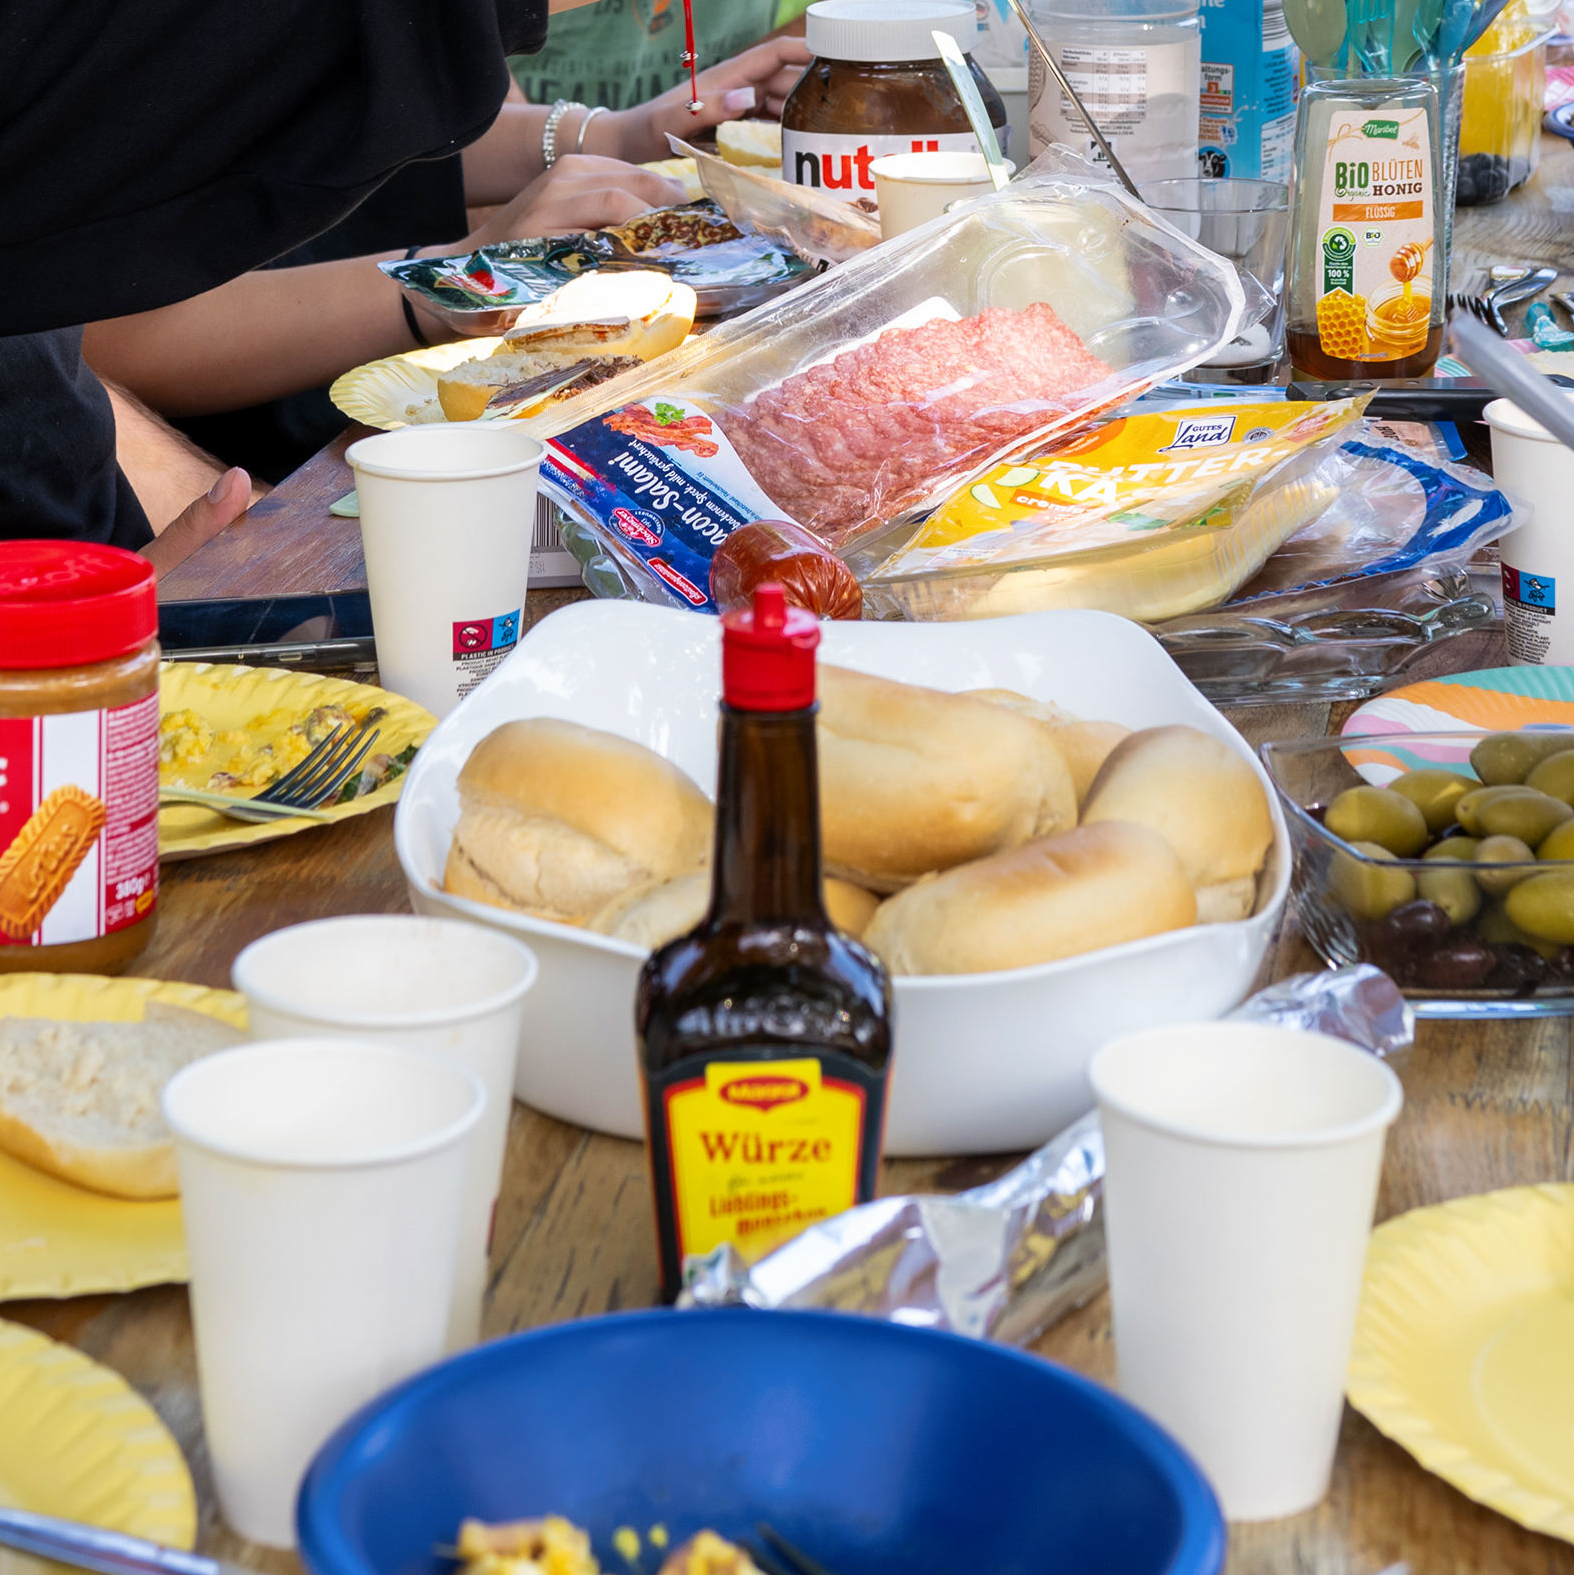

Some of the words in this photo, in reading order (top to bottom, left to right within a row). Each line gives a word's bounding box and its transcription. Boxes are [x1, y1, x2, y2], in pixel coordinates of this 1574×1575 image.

[1204, 73, 1222, 82] form
[1210, 84, 1216, 92] 3
[1364, 123, 1397, 135] Maribel
[1372, 158, 1423, 182] BLÜTEN
[1334, 186, 1370, 201] Organic
[1372, 182, 1423, 197] HONIG
[1365, 205, 1396, 219] FLÜSSIG
[1327, 269, 1342, 278] 100
[1343, 269, 1350, 278] %
[1192, 424, 1222, 432] GUTES
[1158, 424, 1229, 452] Land
[628, 437, 673, 473] geräuchert
[664, 470, 687, 487] mild
[609, 450, 729, 543] acon-Salami
[705, 499, 741, 532] backenem
[1523, 603, 1548, 614] PRODUCT
[461, 652, 487, 660] PLASTIC
[494, 644, 514, 656] PRODUCT
[699, 1130, 832, 1164] Würze
